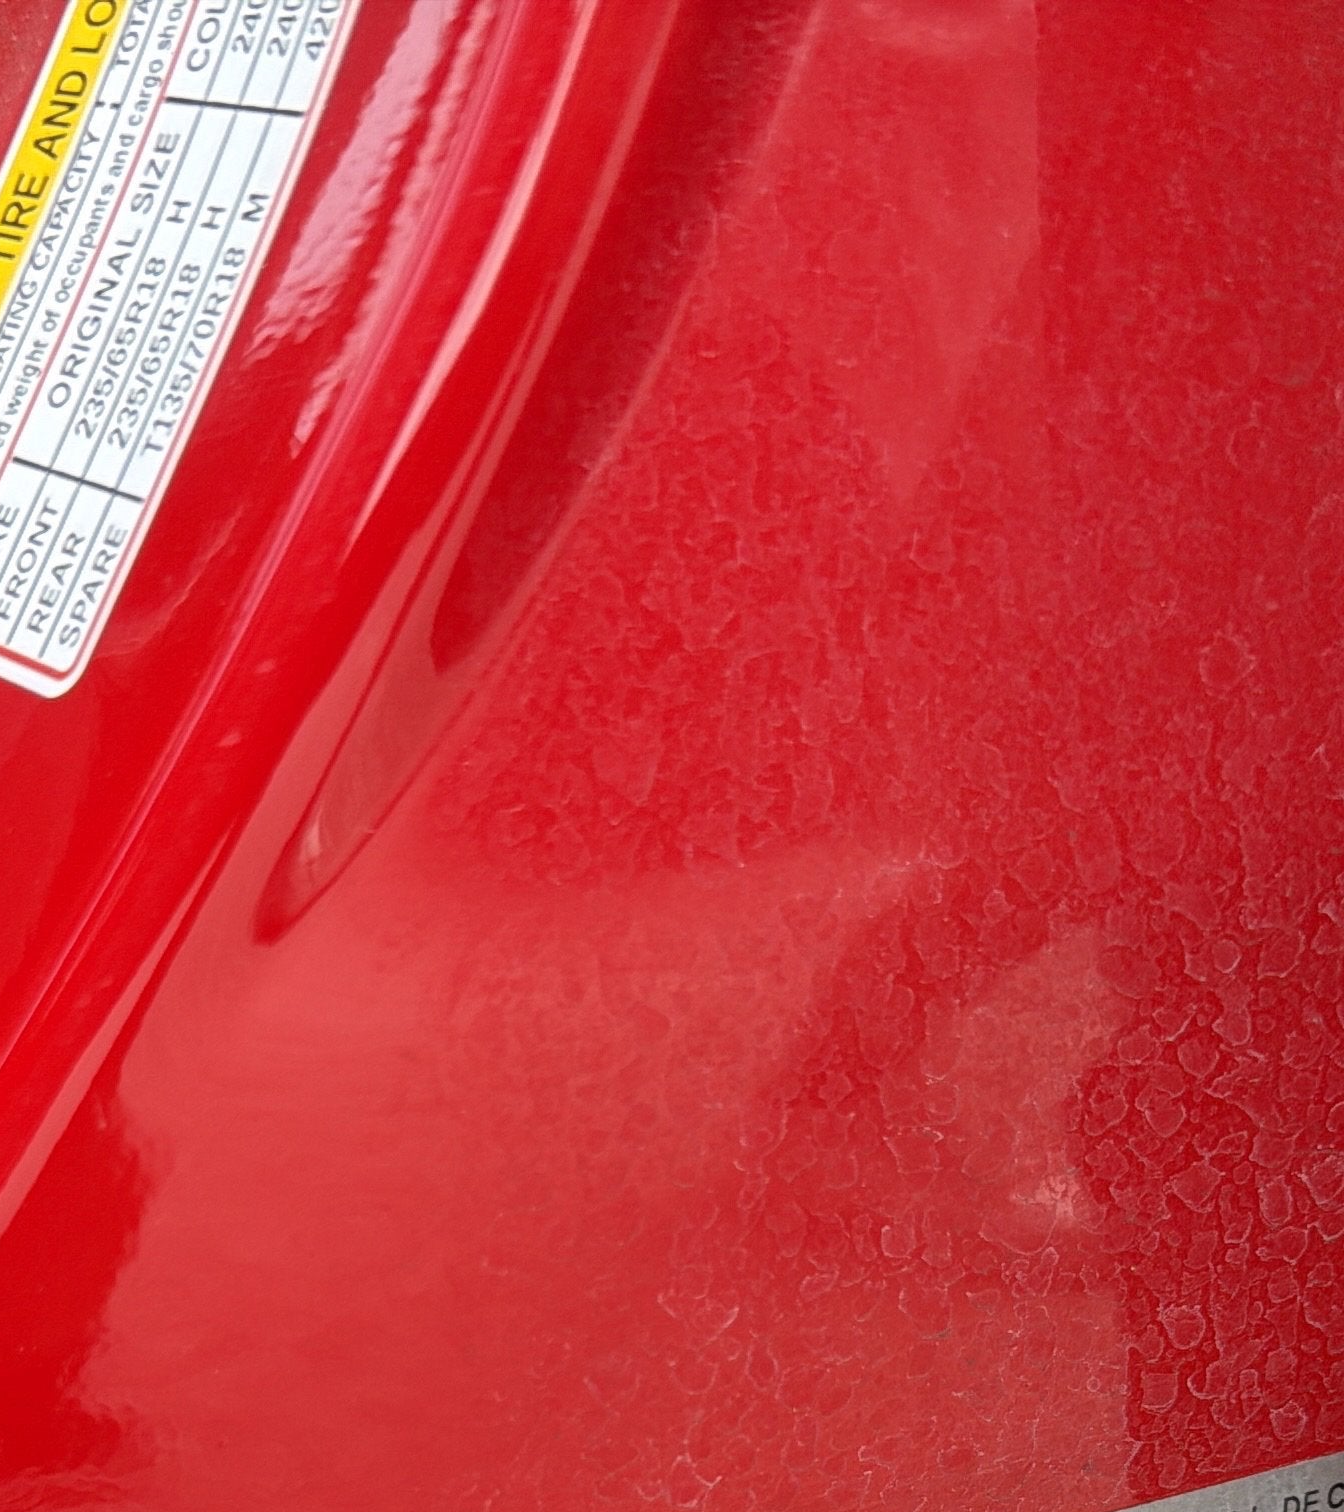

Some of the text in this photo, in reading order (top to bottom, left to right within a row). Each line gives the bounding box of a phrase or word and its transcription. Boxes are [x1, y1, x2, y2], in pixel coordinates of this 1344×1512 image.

[28, 130, 103, 272] CAPACITY
[32, 70, 87, 160] AND
[4, 339, 49, 416] weight
[41, 309, 60, 333] of
[54, 183, 115, 304] occupants
[108, 133, 136, 178] and
[127, 58, 164, 127] cargo
[47, 133, 180, 409] ORIGINAL SIZE
[74, 200, 191, 439] 235/65R18 H
[107, 205, 226, 449] 235/65R18 H
[140, 193, 269, 455] T135/70R18 M
[26, 532, 85, 634] REAR
[58, 525, 127, 648] SPARE
